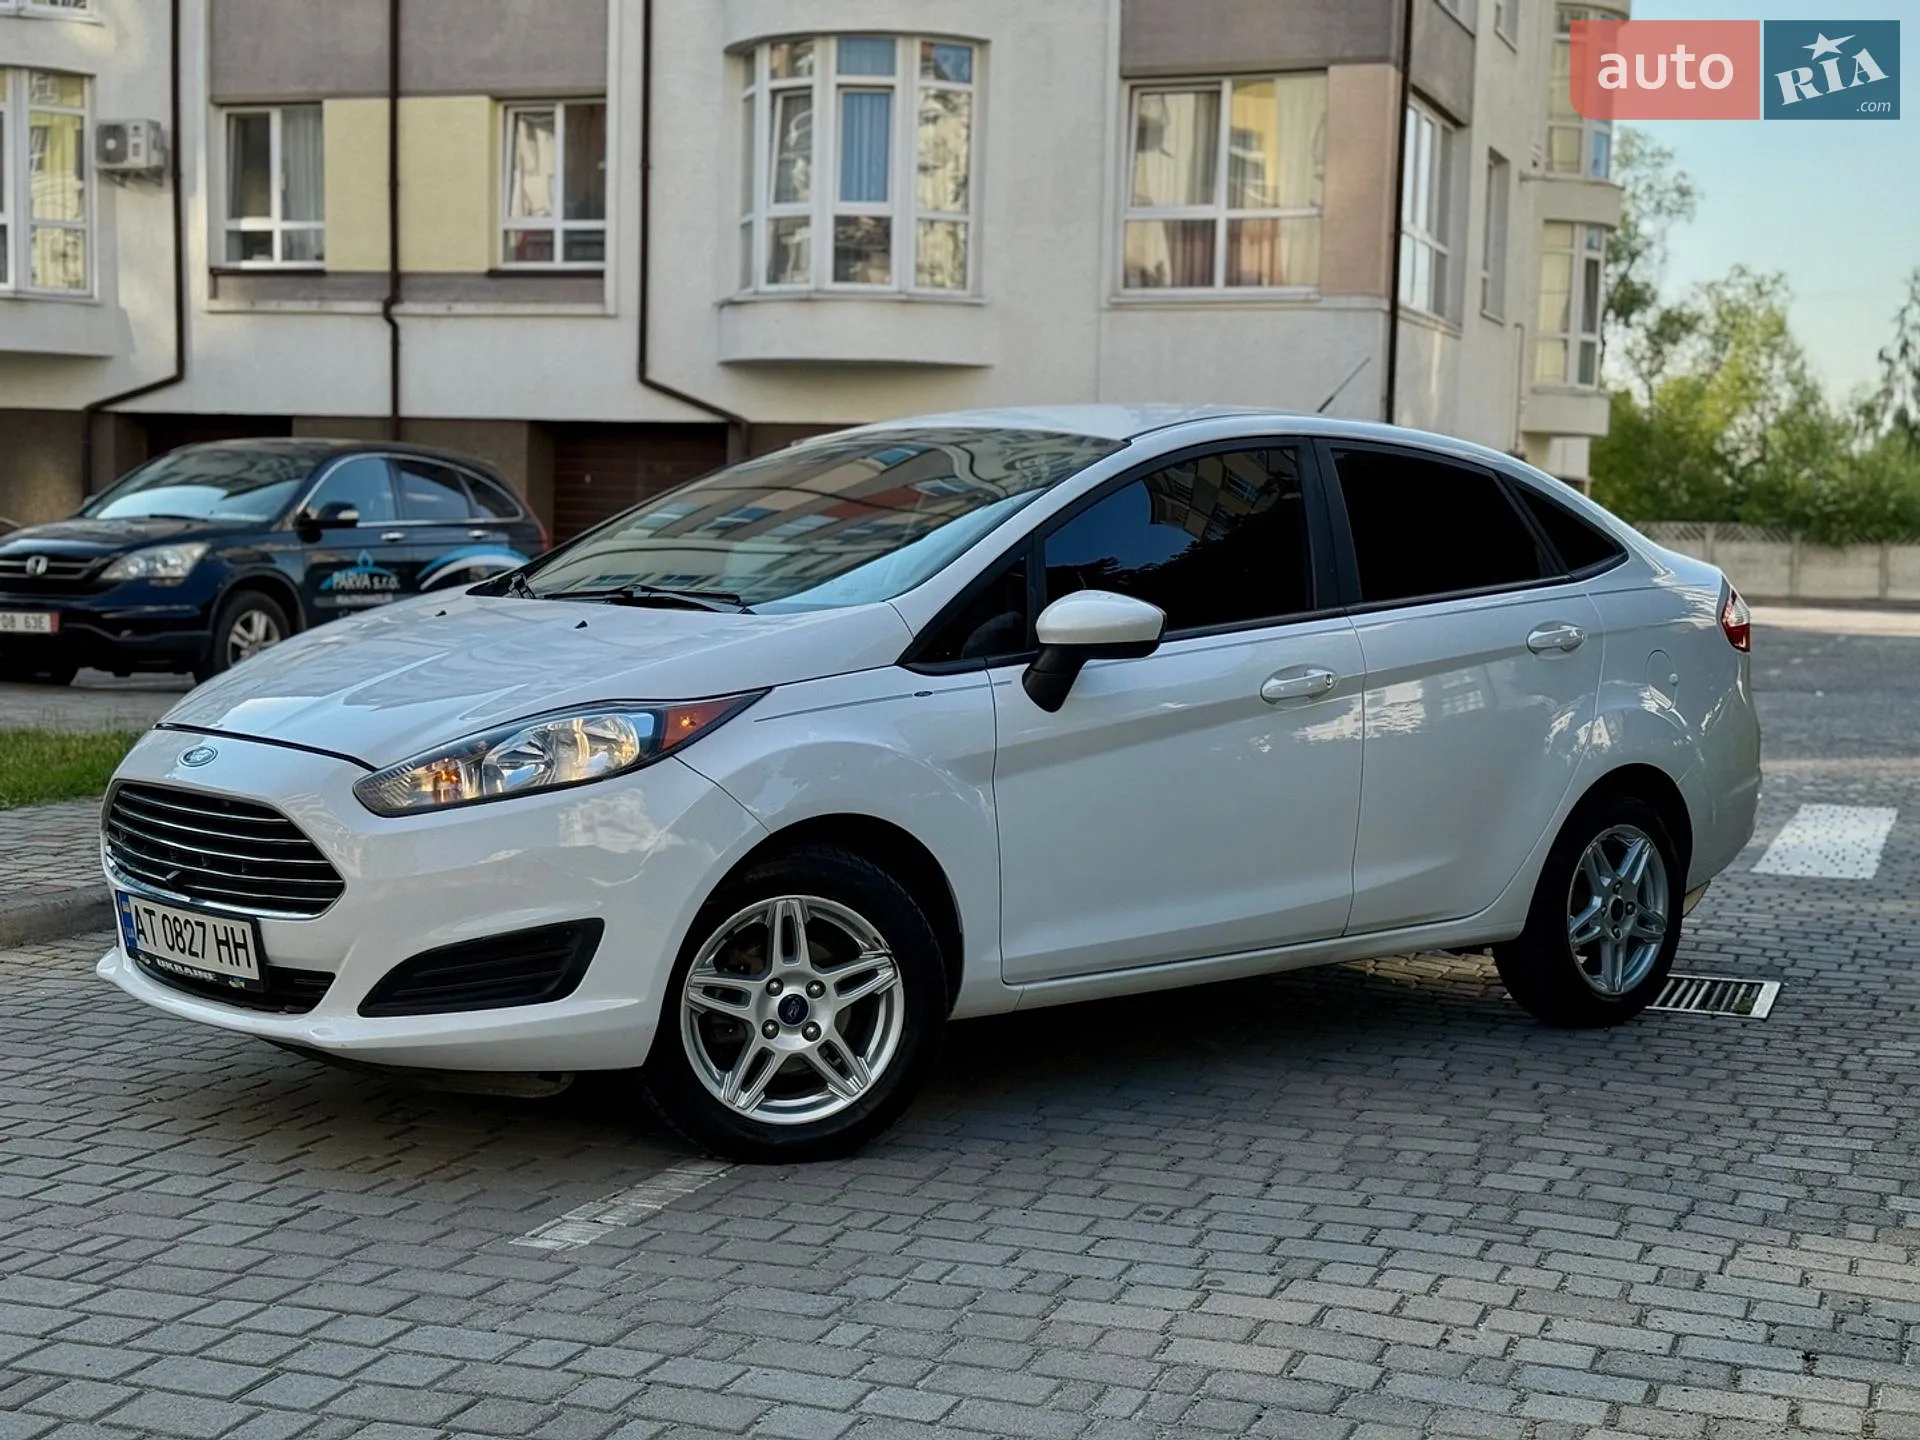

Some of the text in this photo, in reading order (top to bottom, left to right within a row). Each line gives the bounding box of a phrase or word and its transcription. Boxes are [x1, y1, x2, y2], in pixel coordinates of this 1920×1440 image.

[134, 904, 252, 969] AT 0827 HH
